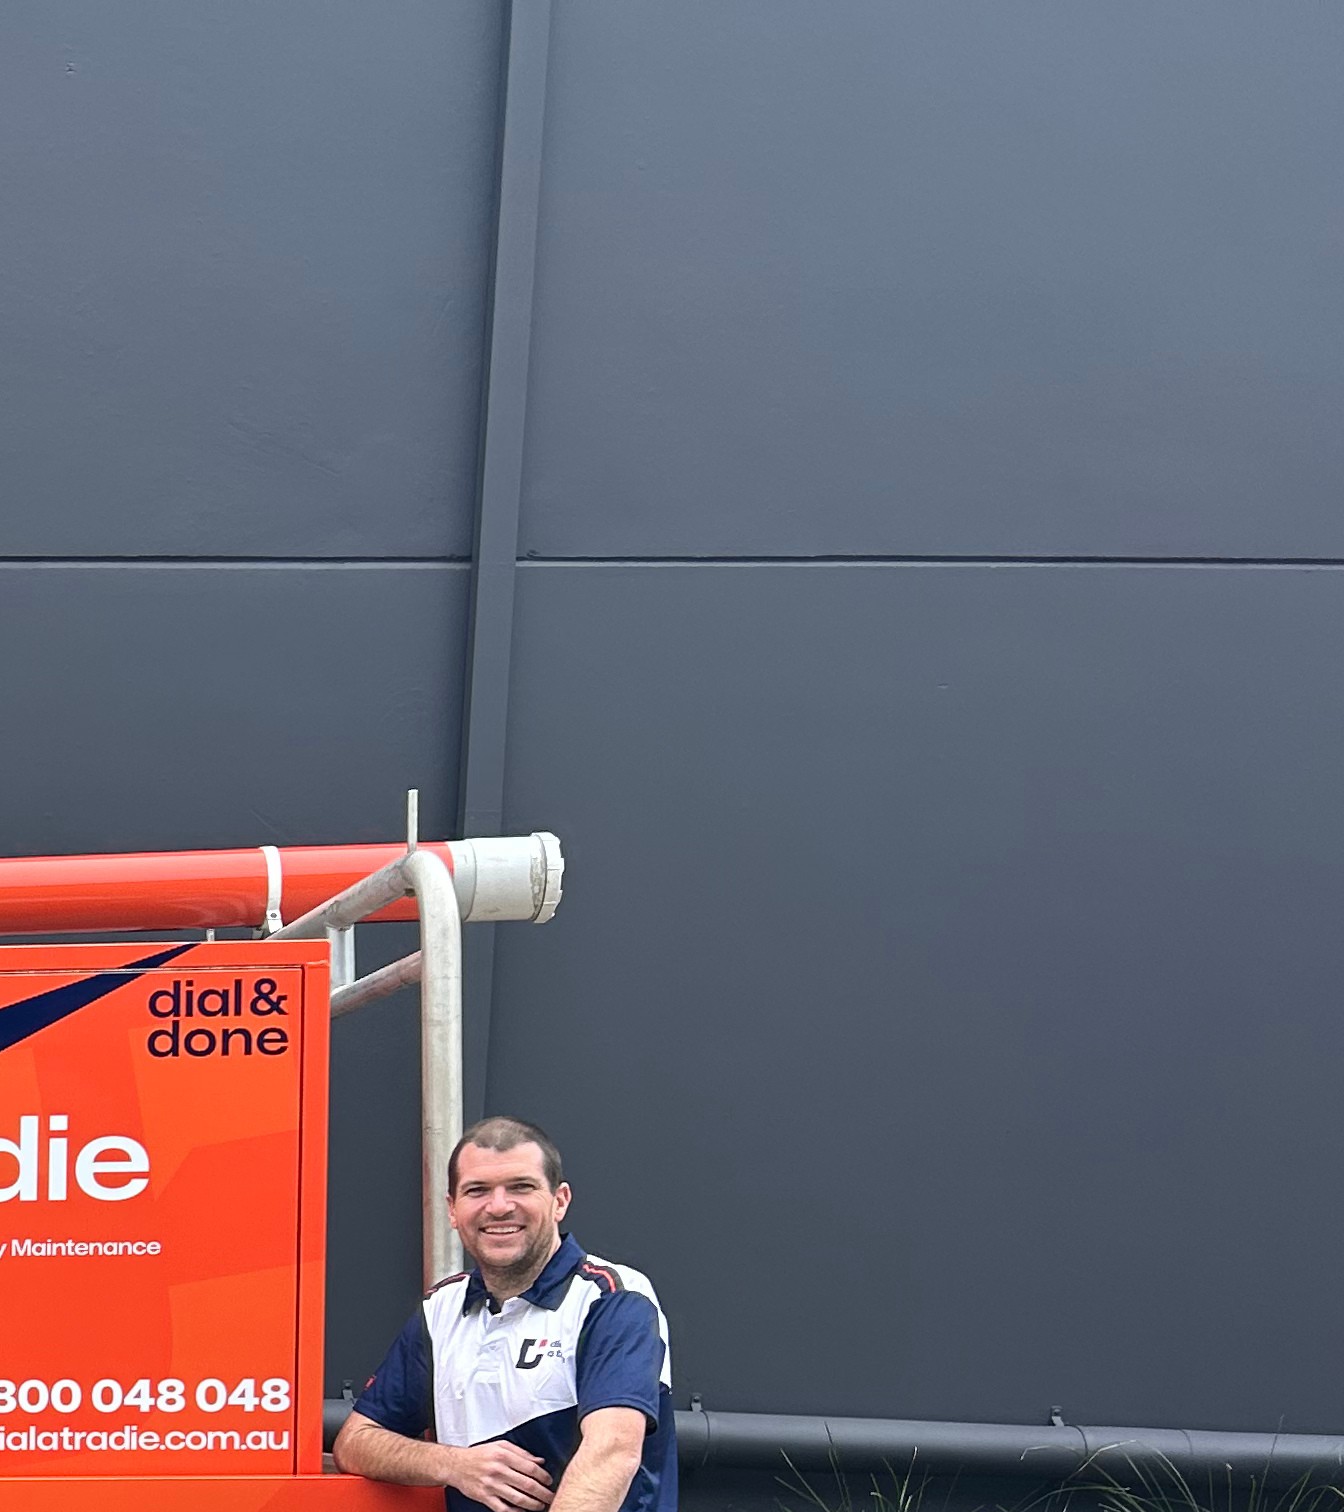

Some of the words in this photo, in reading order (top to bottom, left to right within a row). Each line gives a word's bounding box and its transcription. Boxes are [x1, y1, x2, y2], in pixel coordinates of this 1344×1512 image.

[148, 1017, 289, 1057] done
[11, 1239, 161, 1258] Maintenance
[92, 1379, 186, 1413] 048
[196, 1378, 291, 1413] 048
